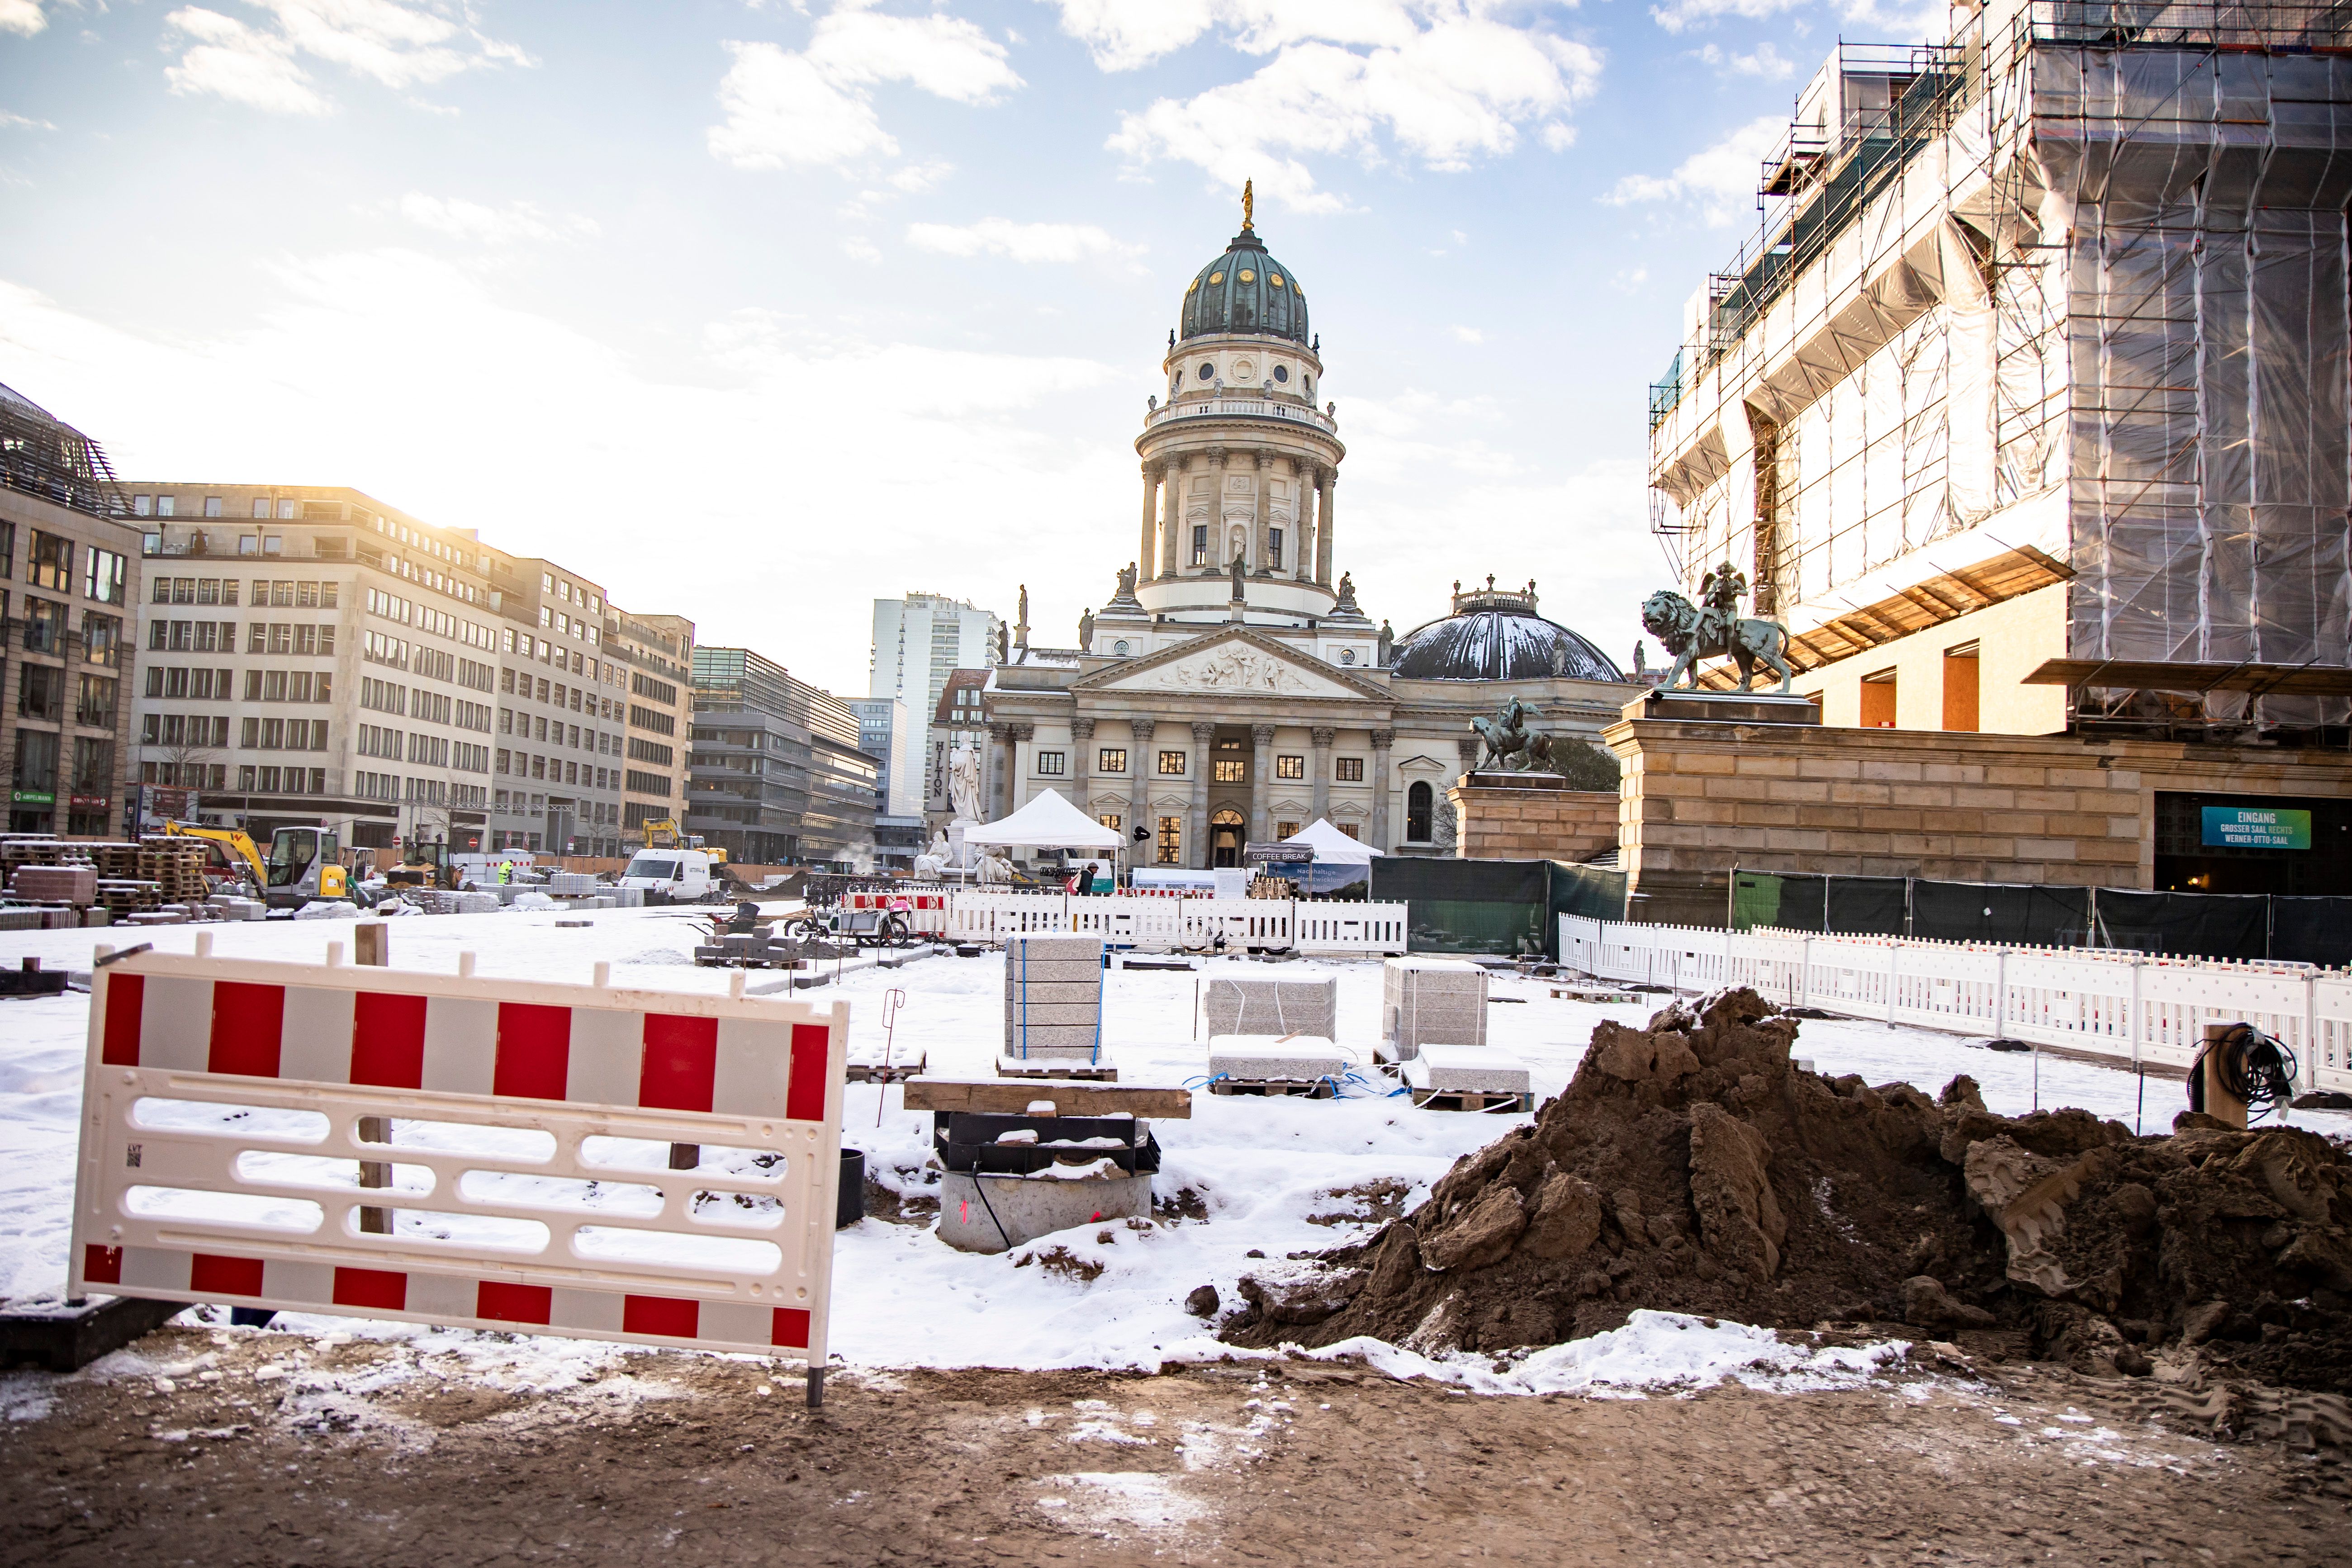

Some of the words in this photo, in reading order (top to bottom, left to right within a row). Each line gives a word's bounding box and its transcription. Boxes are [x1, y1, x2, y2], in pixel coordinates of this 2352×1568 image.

[934, 741, 944, 797] HILTON
[2238, 811, 2276, 824] EINGANG
[2220, 824, 2250, 833] GROSSER
[2251, 825, 2267, 834] SAAL
[2268, 826, 2293, 834] RECHTS
[2225, 834, 2288, 844] WERNER-OTTO-SAAL
[1287, 876, 1345, 884] Sdtentwicklung
